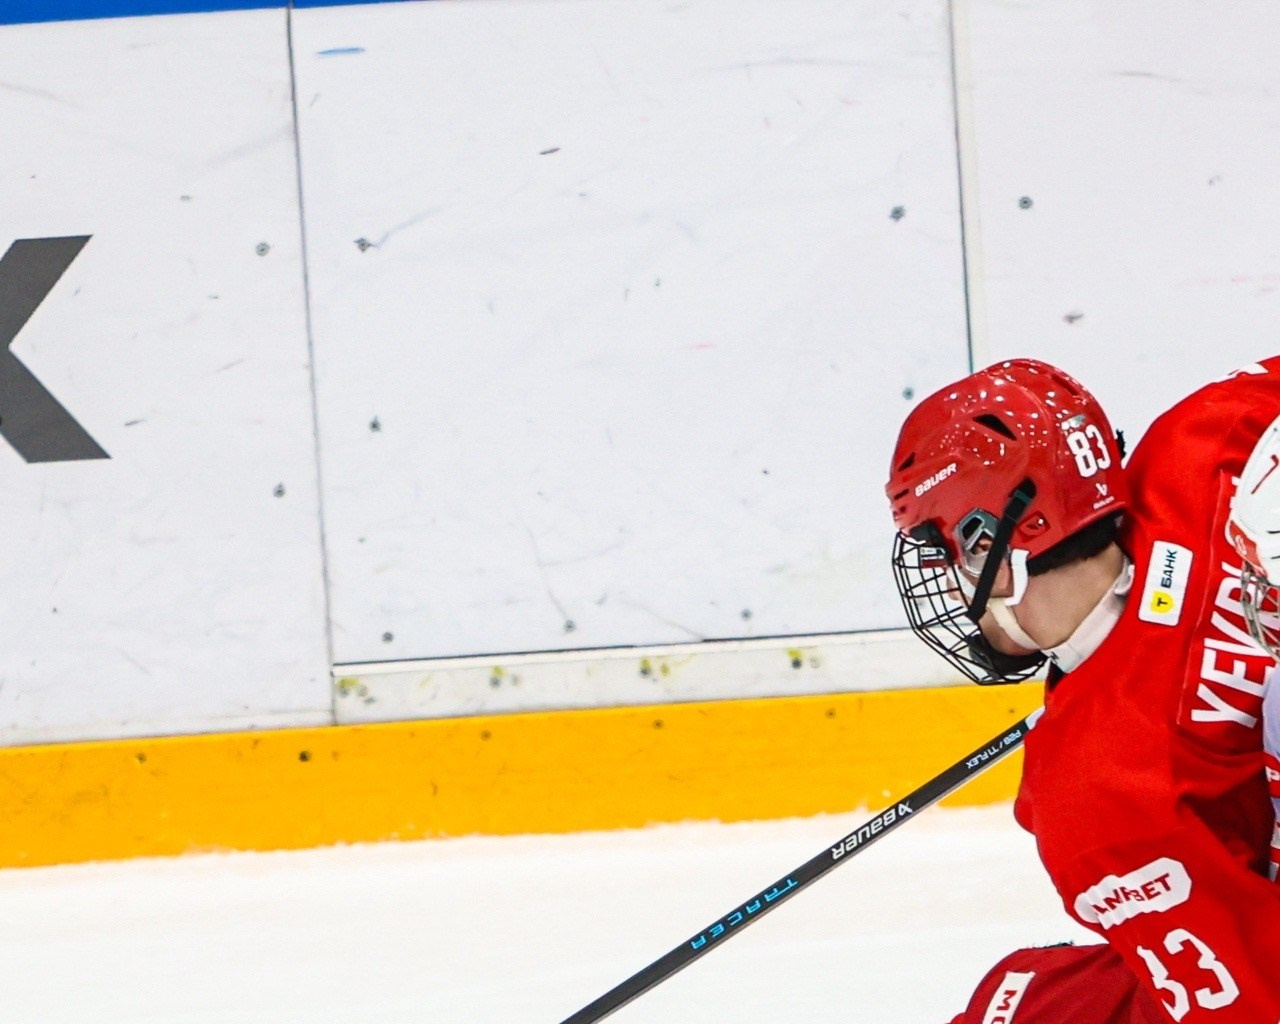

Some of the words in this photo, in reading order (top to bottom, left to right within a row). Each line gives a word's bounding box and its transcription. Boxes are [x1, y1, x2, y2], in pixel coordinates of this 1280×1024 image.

[1066, 424, 1112, 478] 83
[1251, 454, 1280, 494] 7
[915, 462, 958, 497] BAUER
[831, 808, 897, 860] BAUER
[691, 877, 799, 951] TRACER
